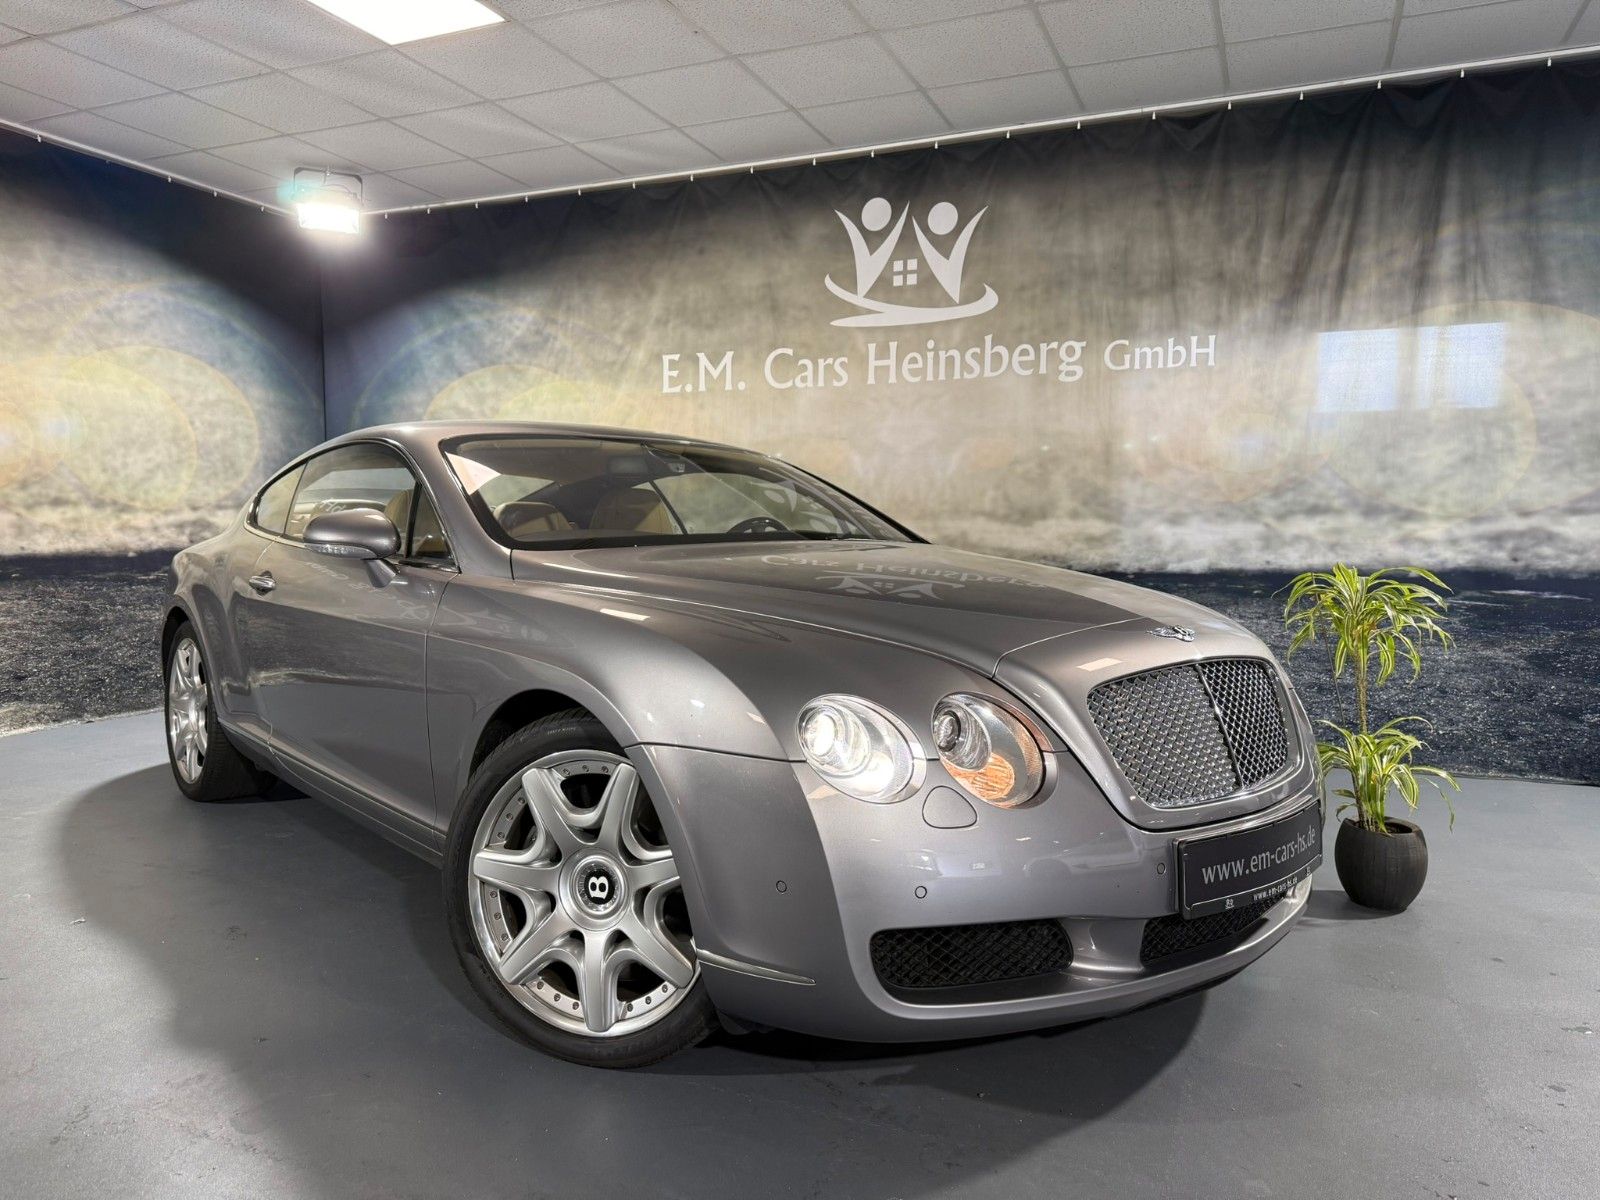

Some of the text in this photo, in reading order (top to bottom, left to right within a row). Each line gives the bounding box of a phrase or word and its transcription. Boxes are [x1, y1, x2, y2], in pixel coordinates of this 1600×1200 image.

[662, 334, 1216, 393] E.M. Cars Heinsberg GmbH
[1202, 825, 1316, 885] www.em-cars-hs.de
